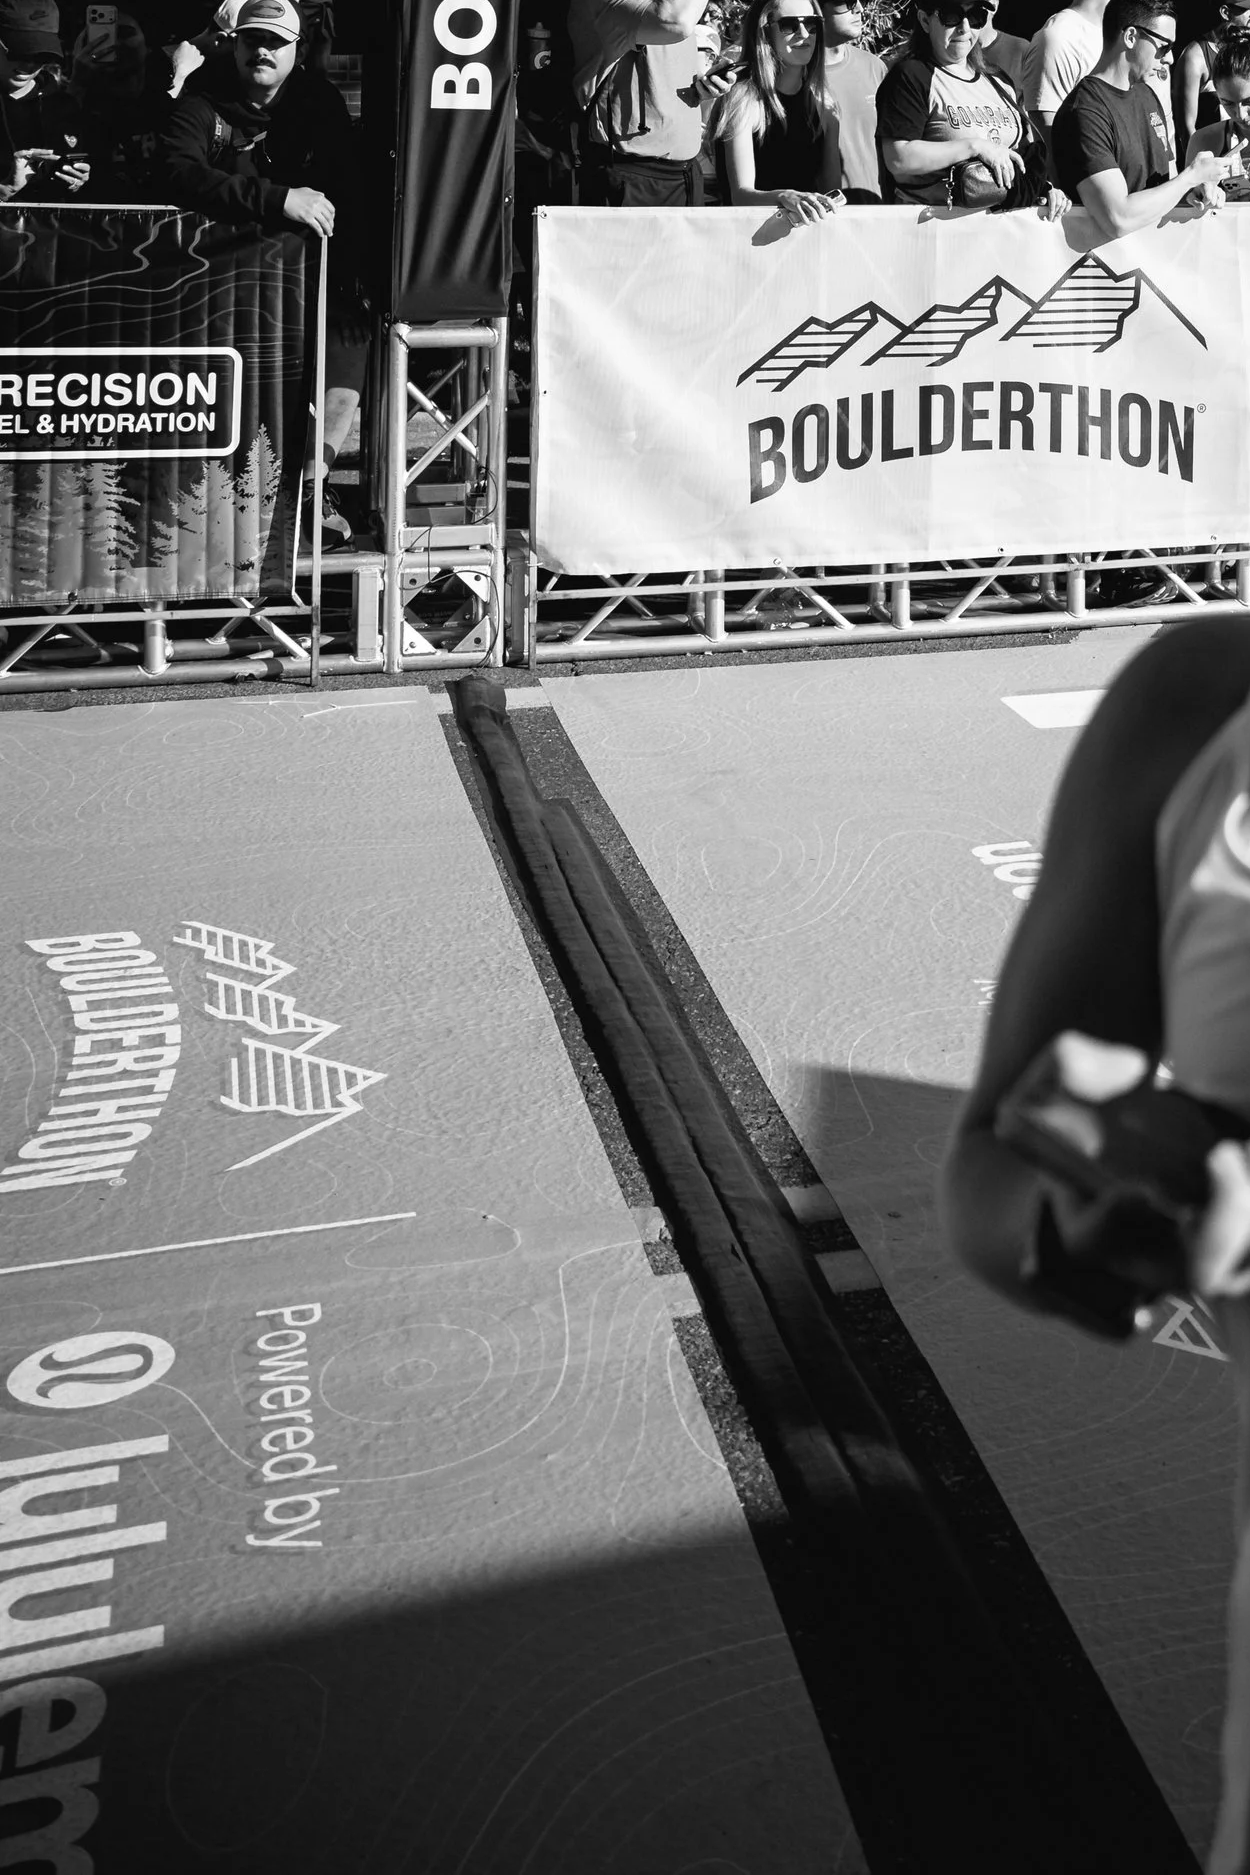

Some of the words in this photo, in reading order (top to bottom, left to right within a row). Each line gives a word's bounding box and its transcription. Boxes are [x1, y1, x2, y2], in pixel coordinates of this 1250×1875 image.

[36, 413, 55, 435] &
[60, 411, 216, 434] HYDRATION
[255, 1302, 338, 1483] Powered
[245, 1487, 341, 1548] by
